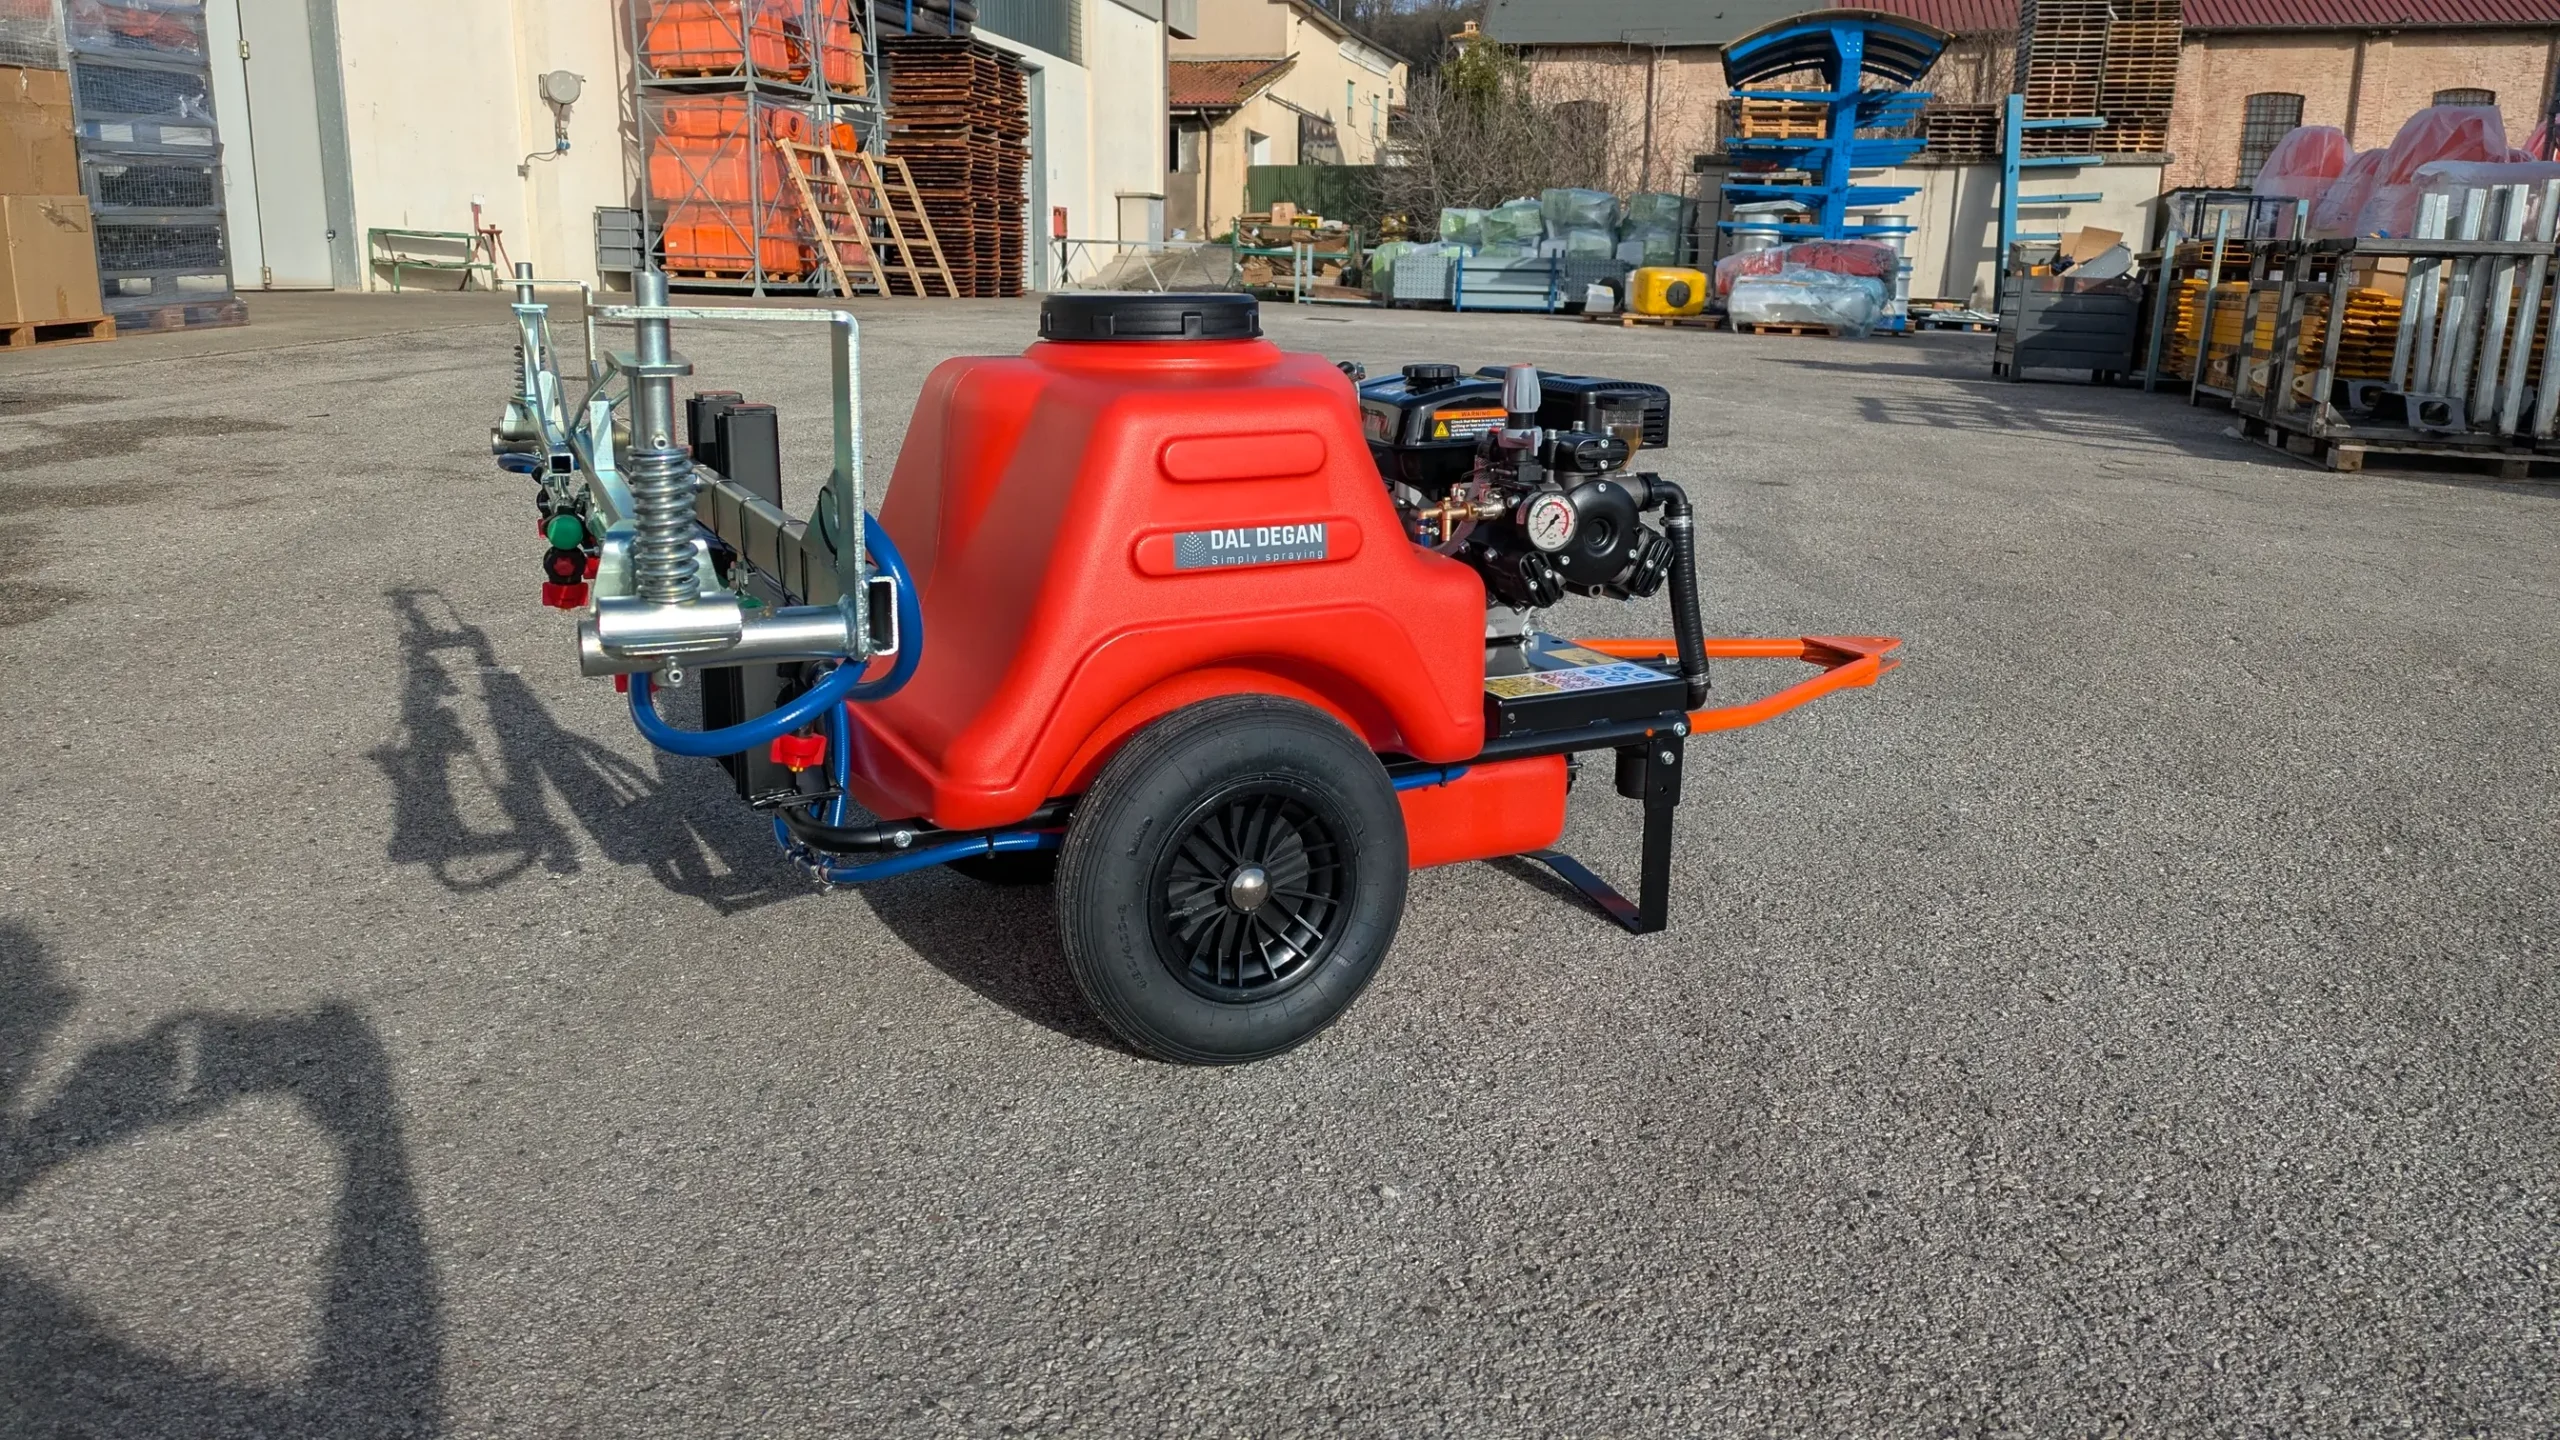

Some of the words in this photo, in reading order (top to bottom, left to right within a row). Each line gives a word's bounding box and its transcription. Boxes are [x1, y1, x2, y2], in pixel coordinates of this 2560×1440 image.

[1210, 528, 1250, 550] DAL
[1256, 523, 1323, 547] DEGAN
[1211, 554, 1258, 565] Simply
[1265, 549, 1323, 562] spraying
